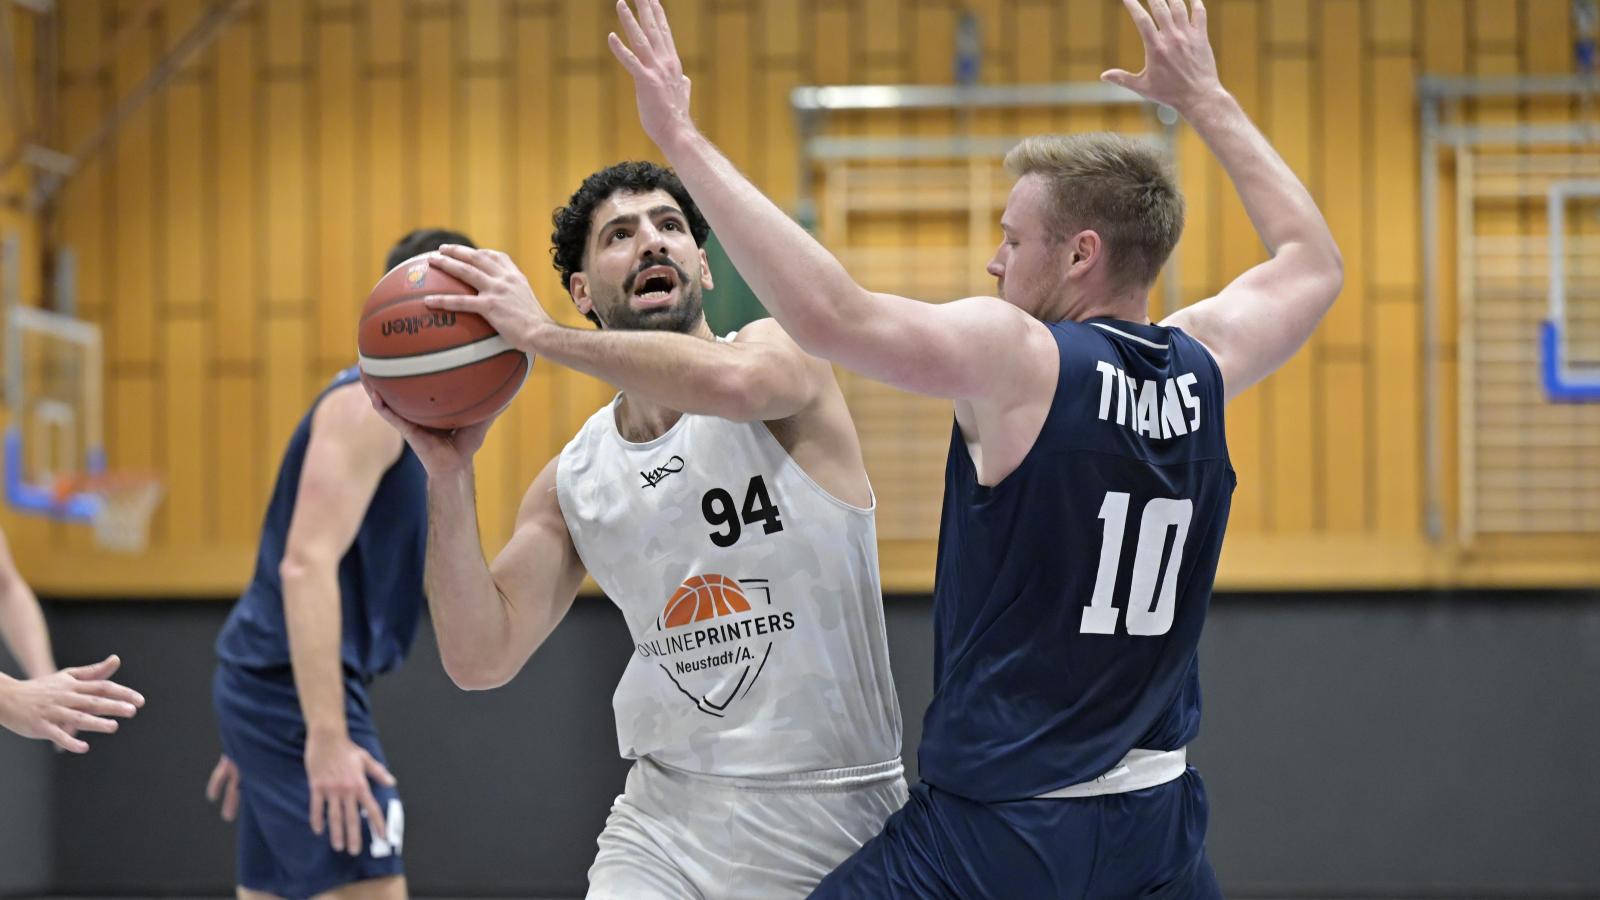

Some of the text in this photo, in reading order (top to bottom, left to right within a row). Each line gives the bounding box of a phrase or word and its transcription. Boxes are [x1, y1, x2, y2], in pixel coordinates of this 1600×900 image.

[381, 311, 456, 336] molten
[1096, 360, 1200, 439] TITANS
[702, 475, 783, 547] 94
[1079, 491, 1193, 636] 10
[637, 612, 795, 658] ONLINEPRINTERS
[676, 646, 754, 674] Neustadt/A.
